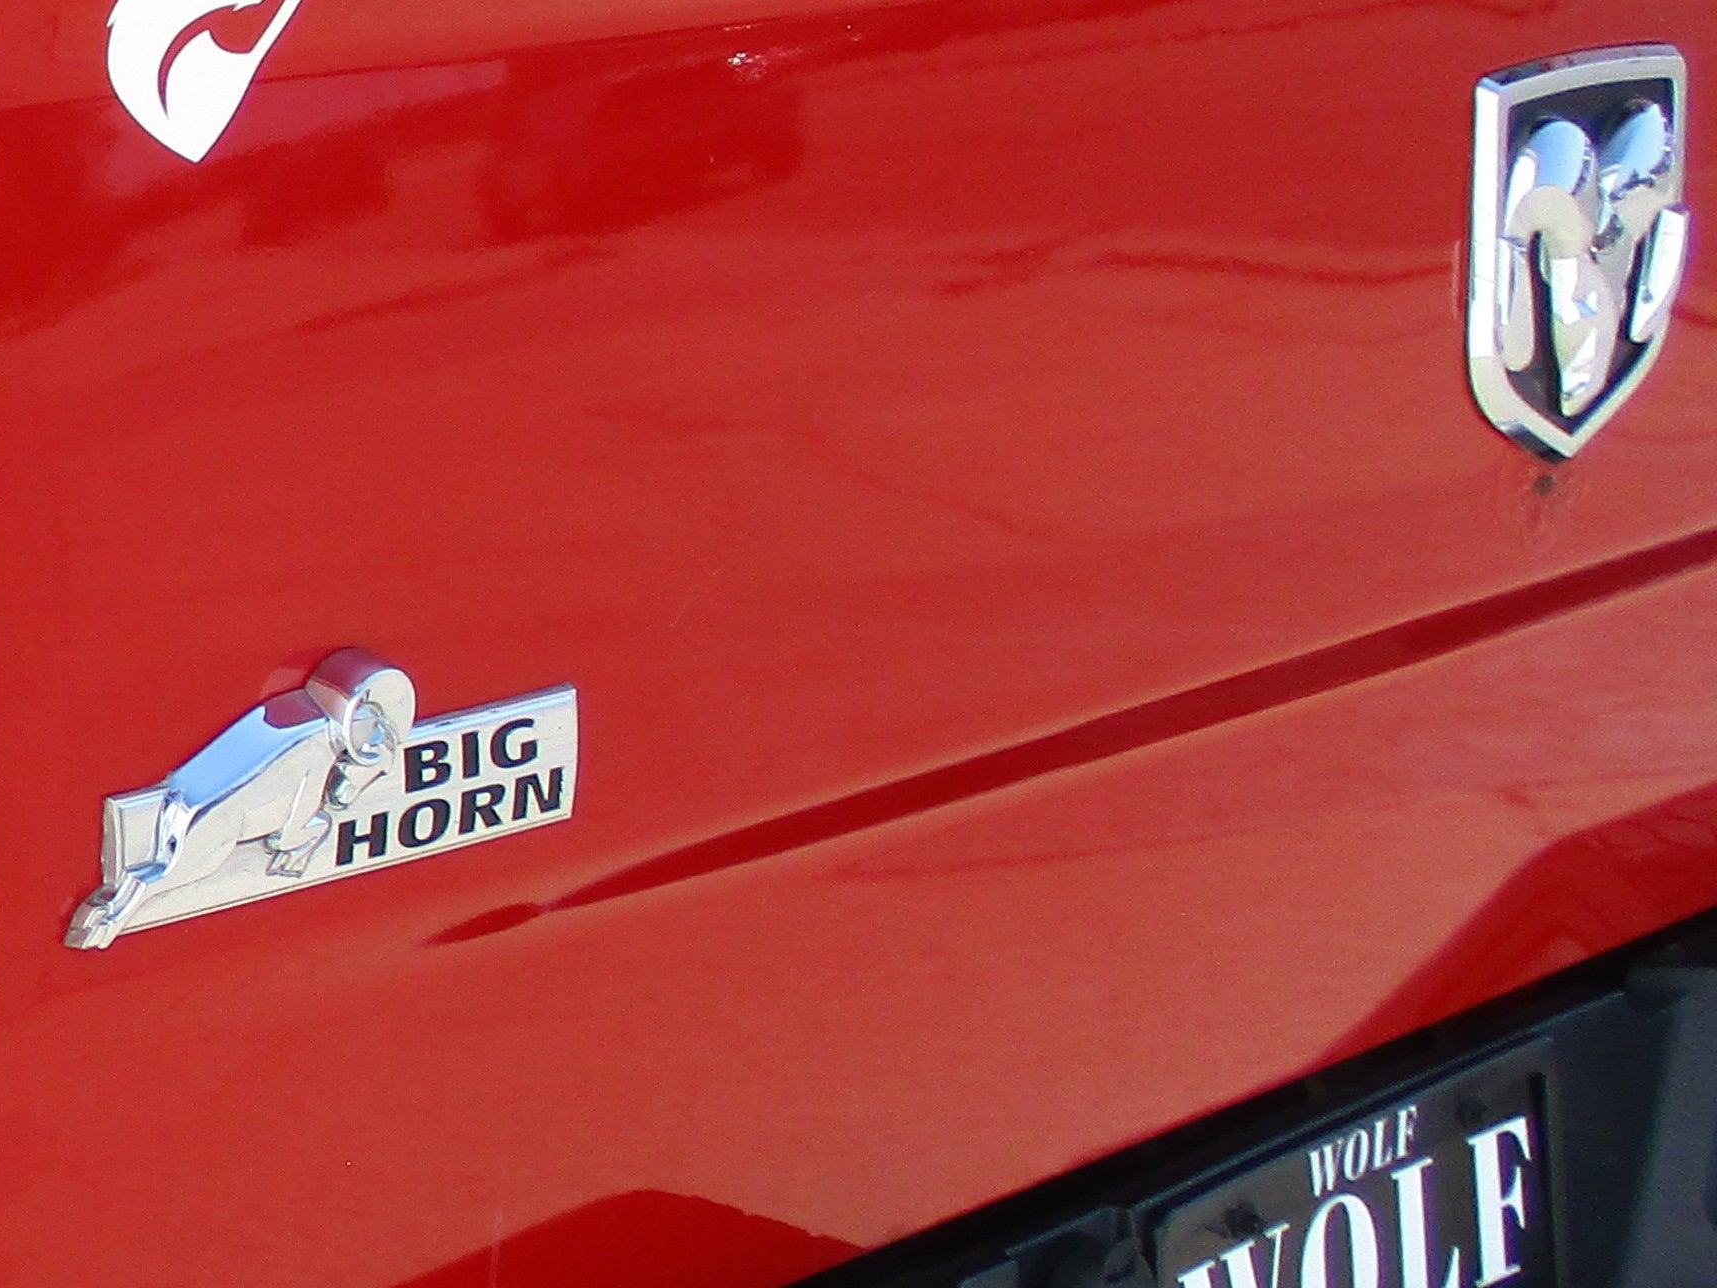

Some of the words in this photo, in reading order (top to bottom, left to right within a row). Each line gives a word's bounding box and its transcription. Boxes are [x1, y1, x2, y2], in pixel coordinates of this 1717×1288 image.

[403, 717, 538, 794] BIG
[335, 767, 565, 867] HORN
[1308, 1104, 1419, 1198] WOLF
